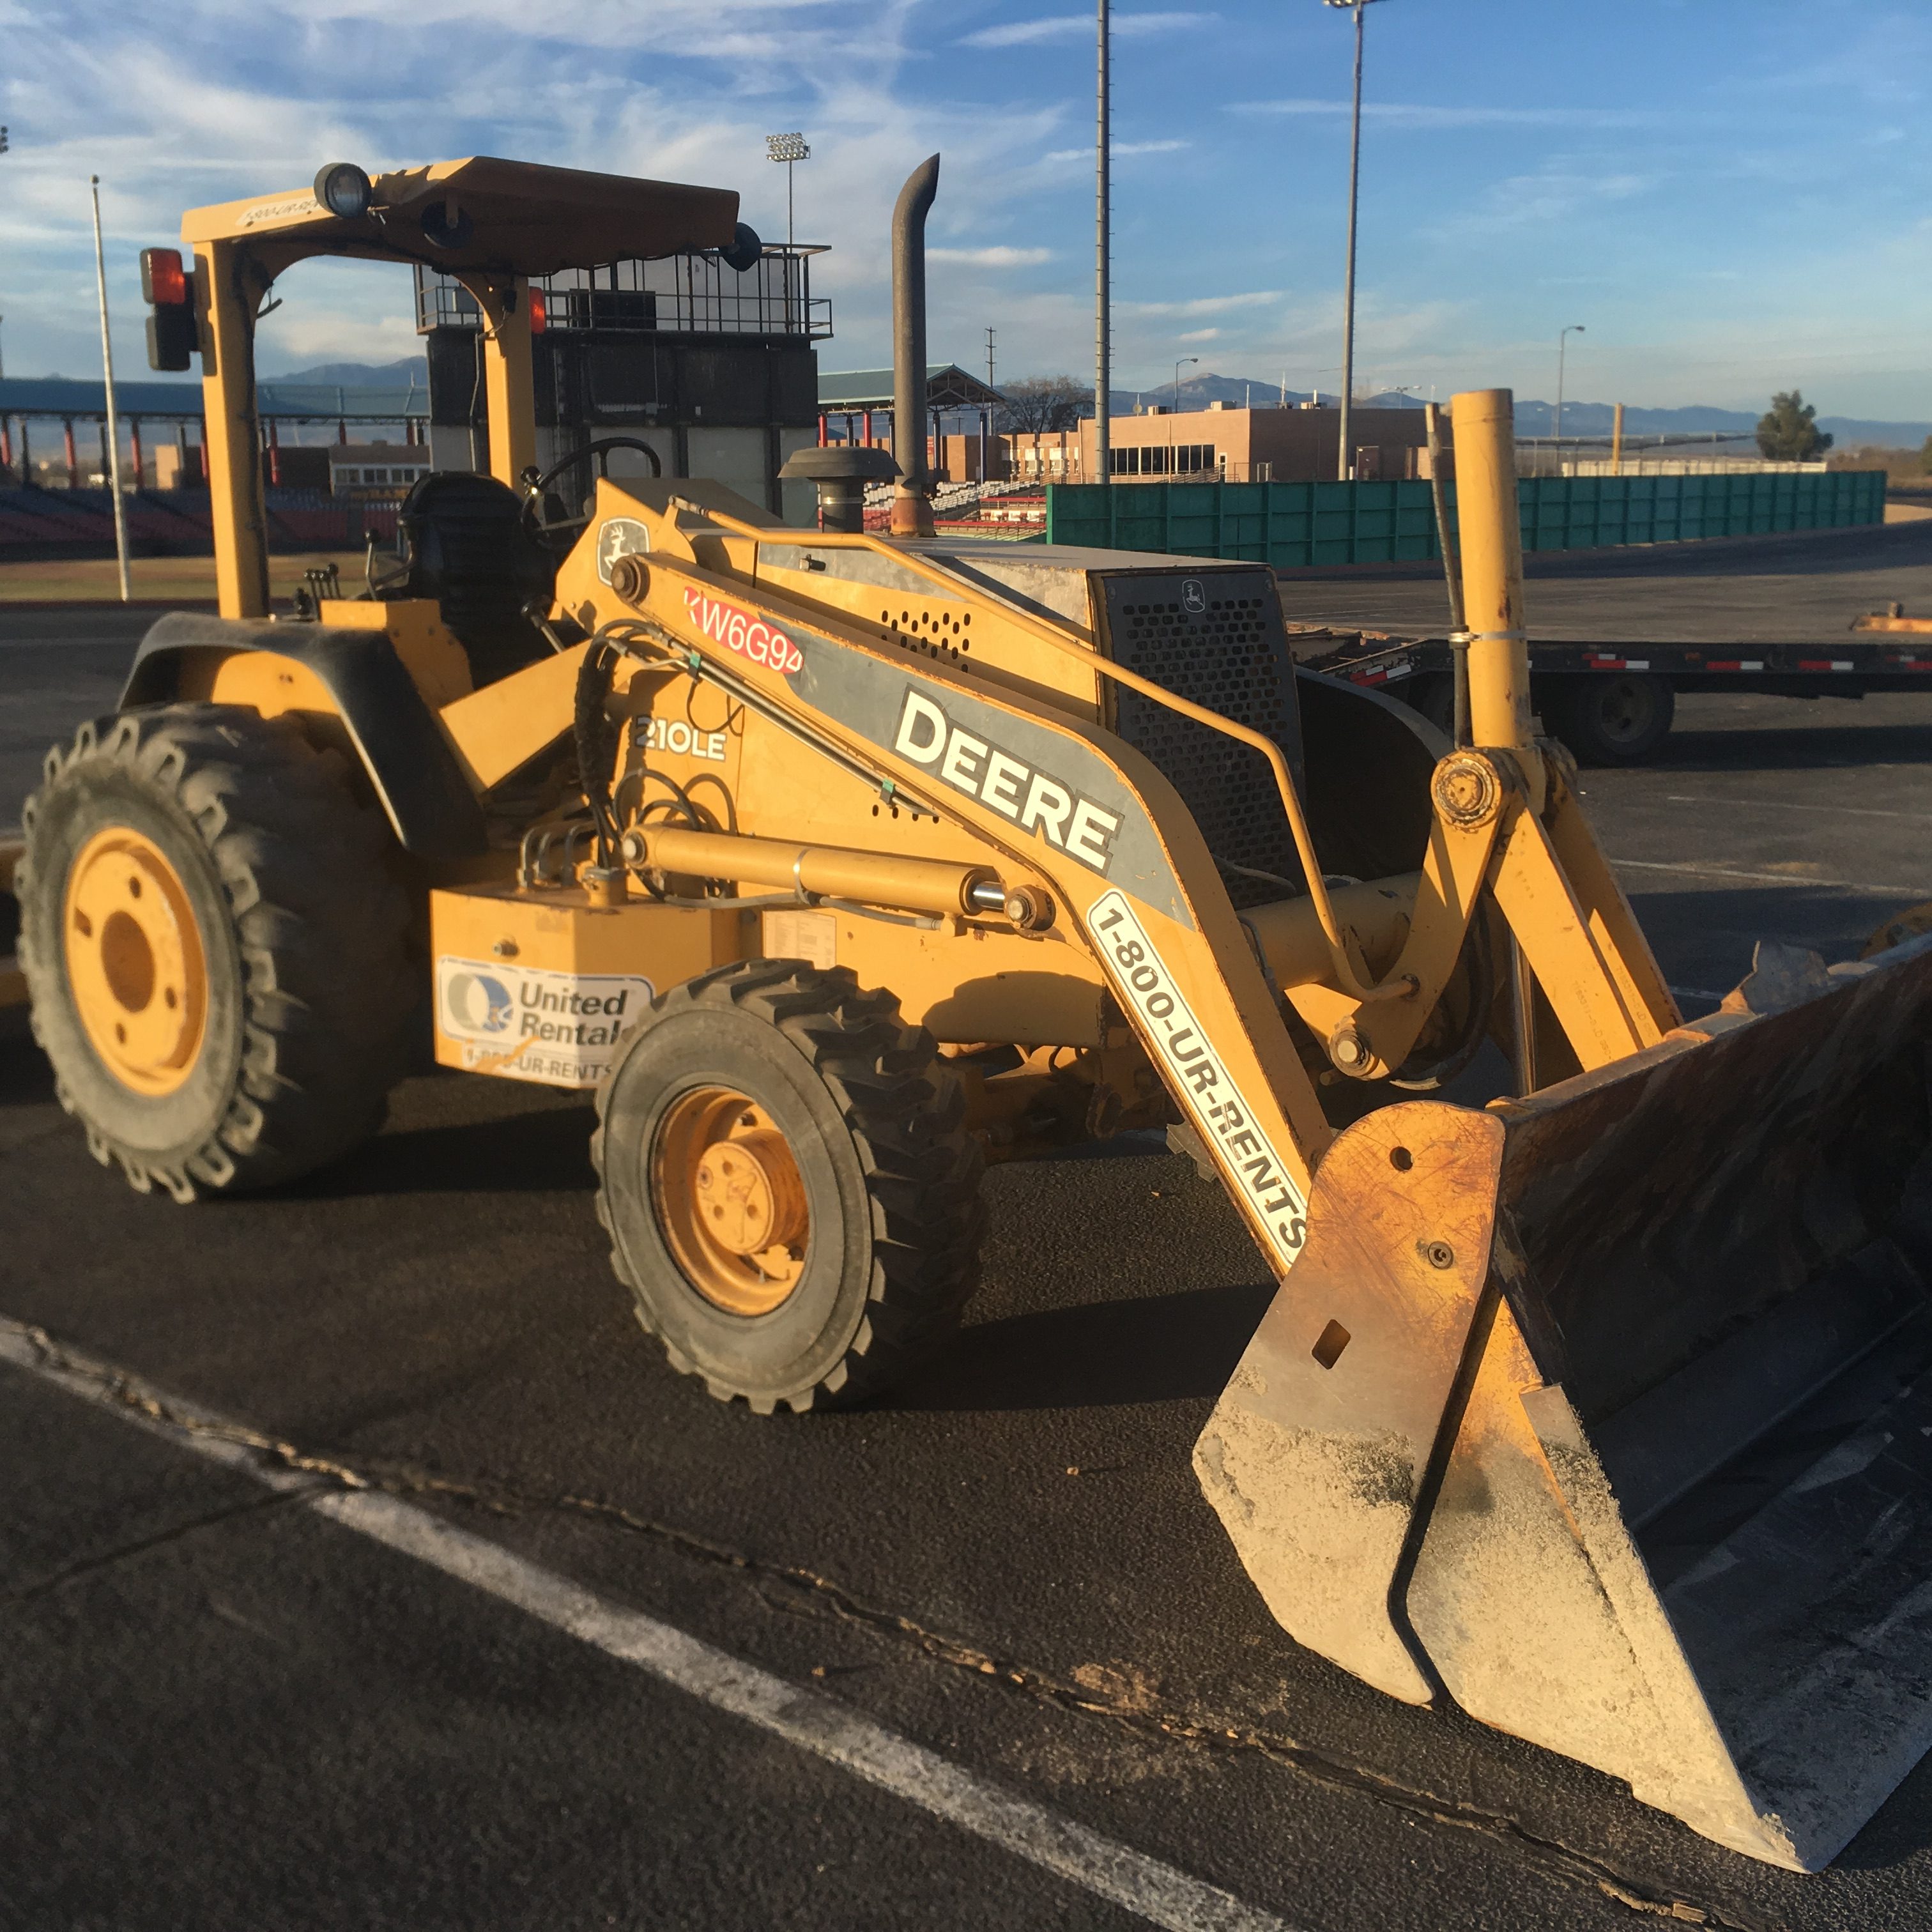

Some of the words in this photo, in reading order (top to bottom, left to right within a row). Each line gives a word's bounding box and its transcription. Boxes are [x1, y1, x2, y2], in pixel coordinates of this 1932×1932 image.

[636, 716, 727, 761] 210LE
[894, 689, 1120, 871] DEERE
[519, 981, 628, 1016] United
[1098, 907, 1307, 1249] 1-800-UR-RENTS
